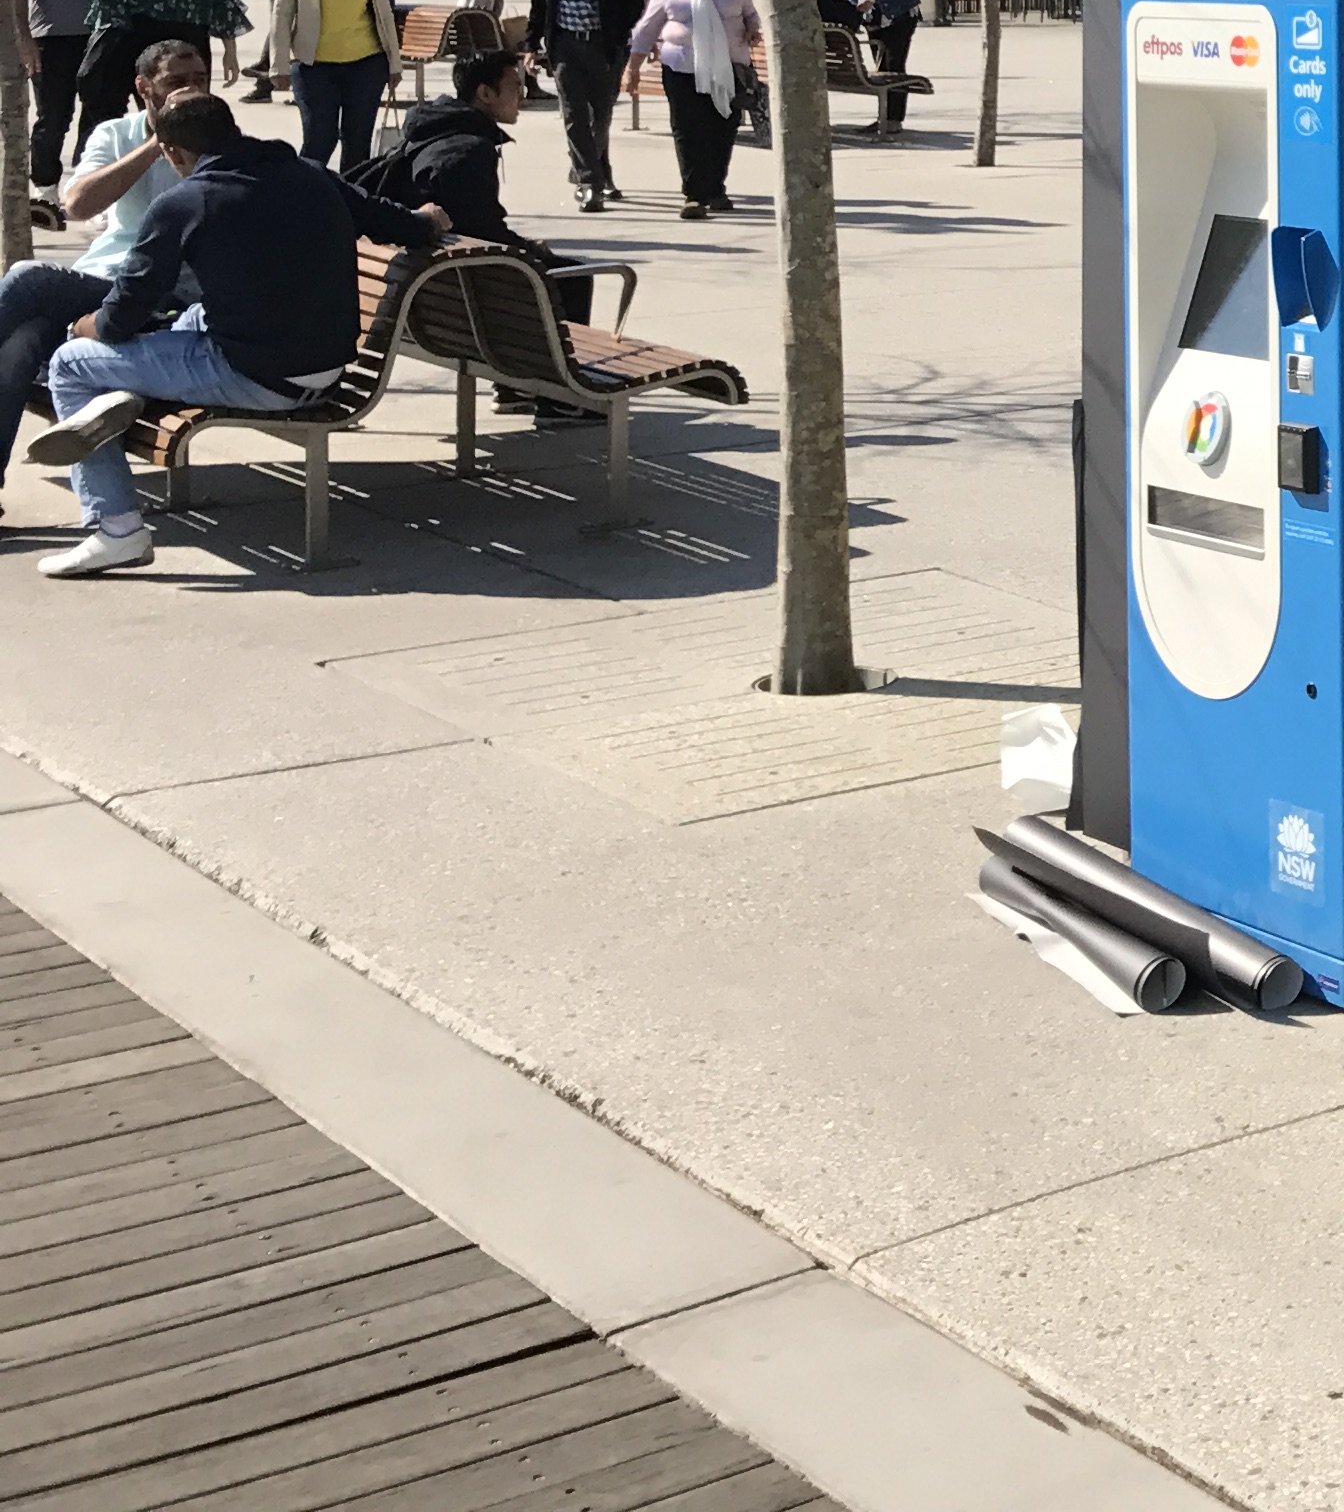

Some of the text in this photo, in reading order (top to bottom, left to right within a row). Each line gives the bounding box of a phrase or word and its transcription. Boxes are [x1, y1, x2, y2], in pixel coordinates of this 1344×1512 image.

[1143, 34, 1183, 61] eftpos
[1191, 40, 1220, 59] VISA
[1289, 55, 1327, 76] Cards
[1293, 80, 1323, 103] only
[1278, 851, 1316, 883] NSW
